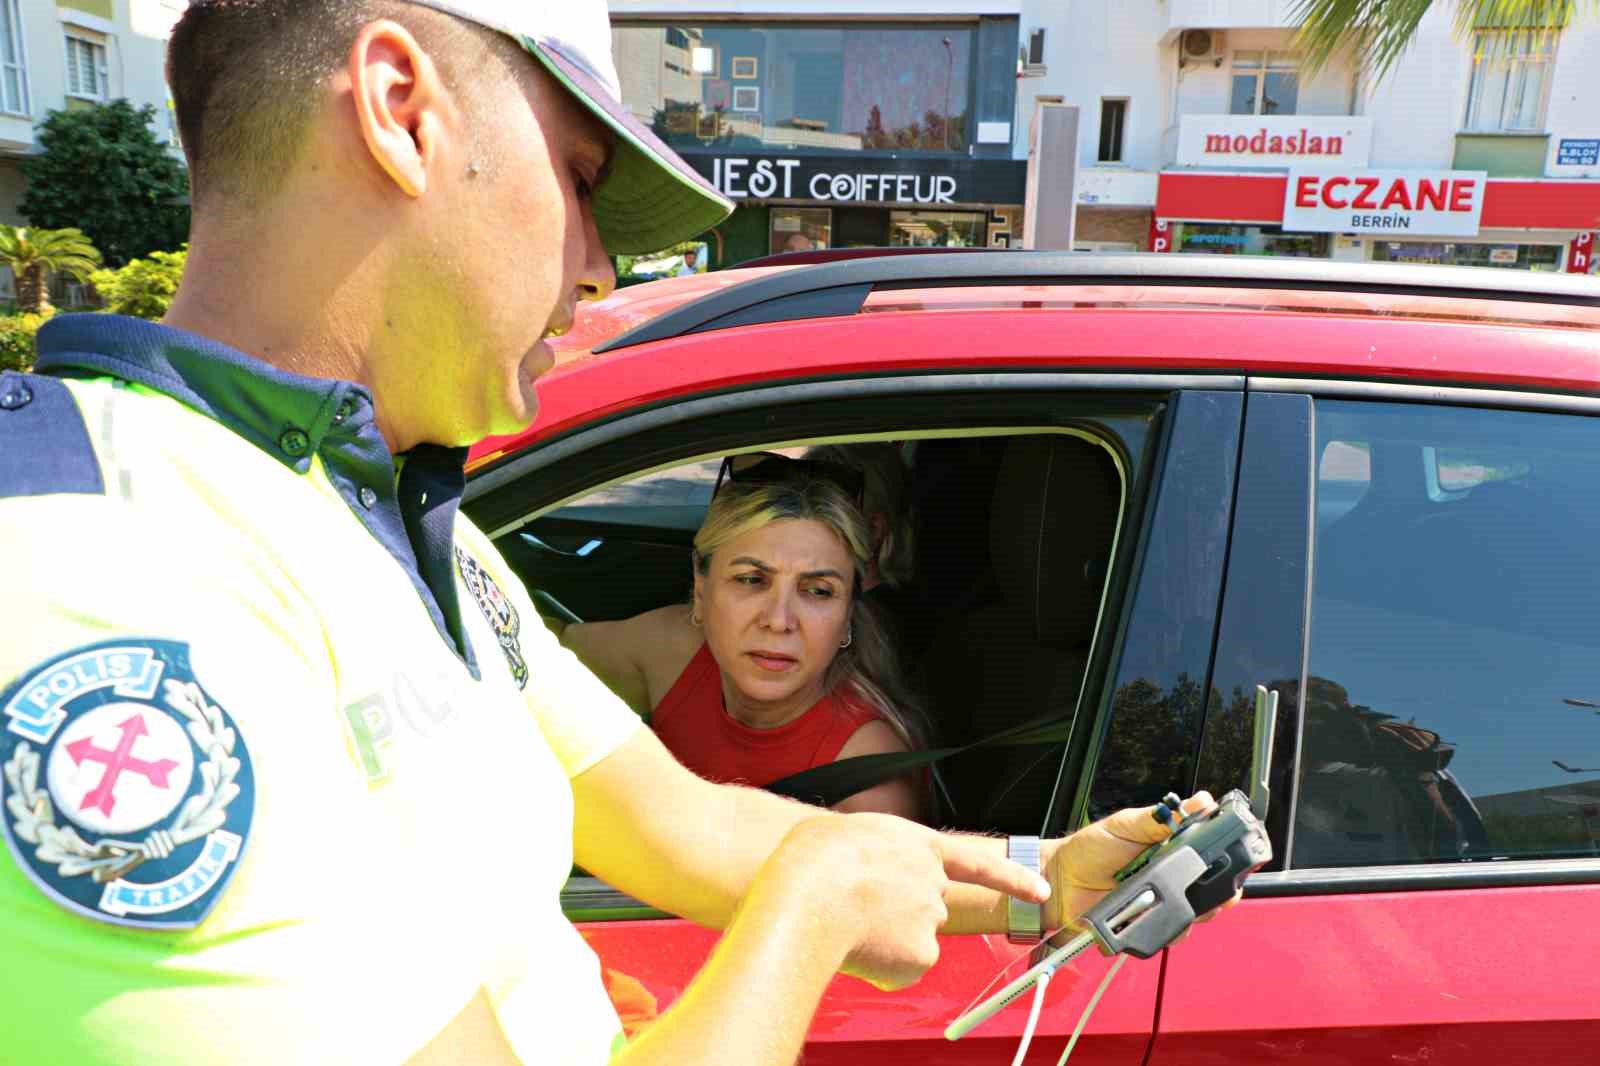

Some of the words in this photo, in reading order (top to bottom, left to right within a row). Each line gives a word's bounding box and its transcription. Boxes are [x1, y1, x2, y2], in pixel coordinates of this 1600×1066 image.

[1204, 128, 1344, 155] modaslan
[809, 173, 957, 204] COIFFEUR
[1295, 176, 1476, 212] ECZANE
[1351, 212, 1410, 229] BERRİN
